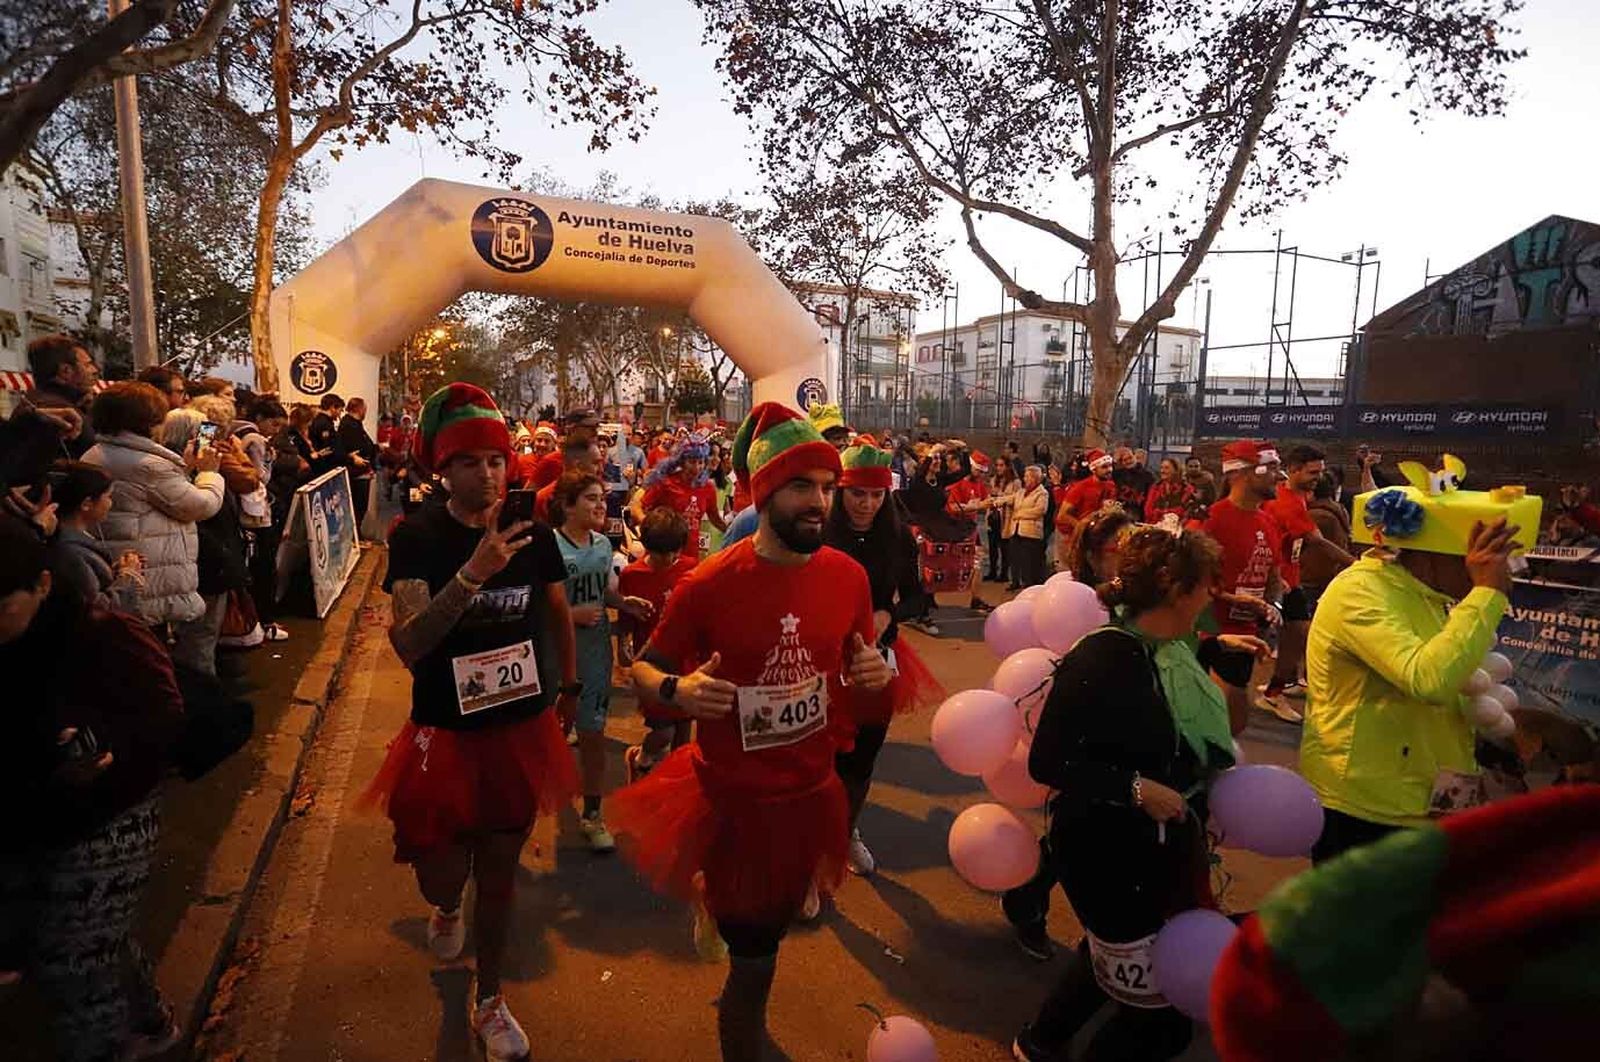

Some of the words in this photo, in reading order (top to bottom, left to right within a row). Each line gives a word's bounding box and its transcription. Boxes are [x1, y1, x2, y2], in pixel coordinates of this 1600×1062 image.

[557, 211, 693, 238] Ayuntamiento
[598, 231, 622, 247] de
[628, 234, 694, 255] Huelva
[629, 254, 643, 263] de
[646, 255, 696, 269] Deportes
[1222, 413, 1260, 422] HYUNDAI
[1290, 413, 1334, 422] HYUNDAI
[1380, 412, 1437, 423] HYUNDAI
[1479, 411, 1548, 422] HYUNDAI
[1540, 626, 1571, 642] de
[497, 662, 523, 688] 20
[779, 694, 820, 726] 403
